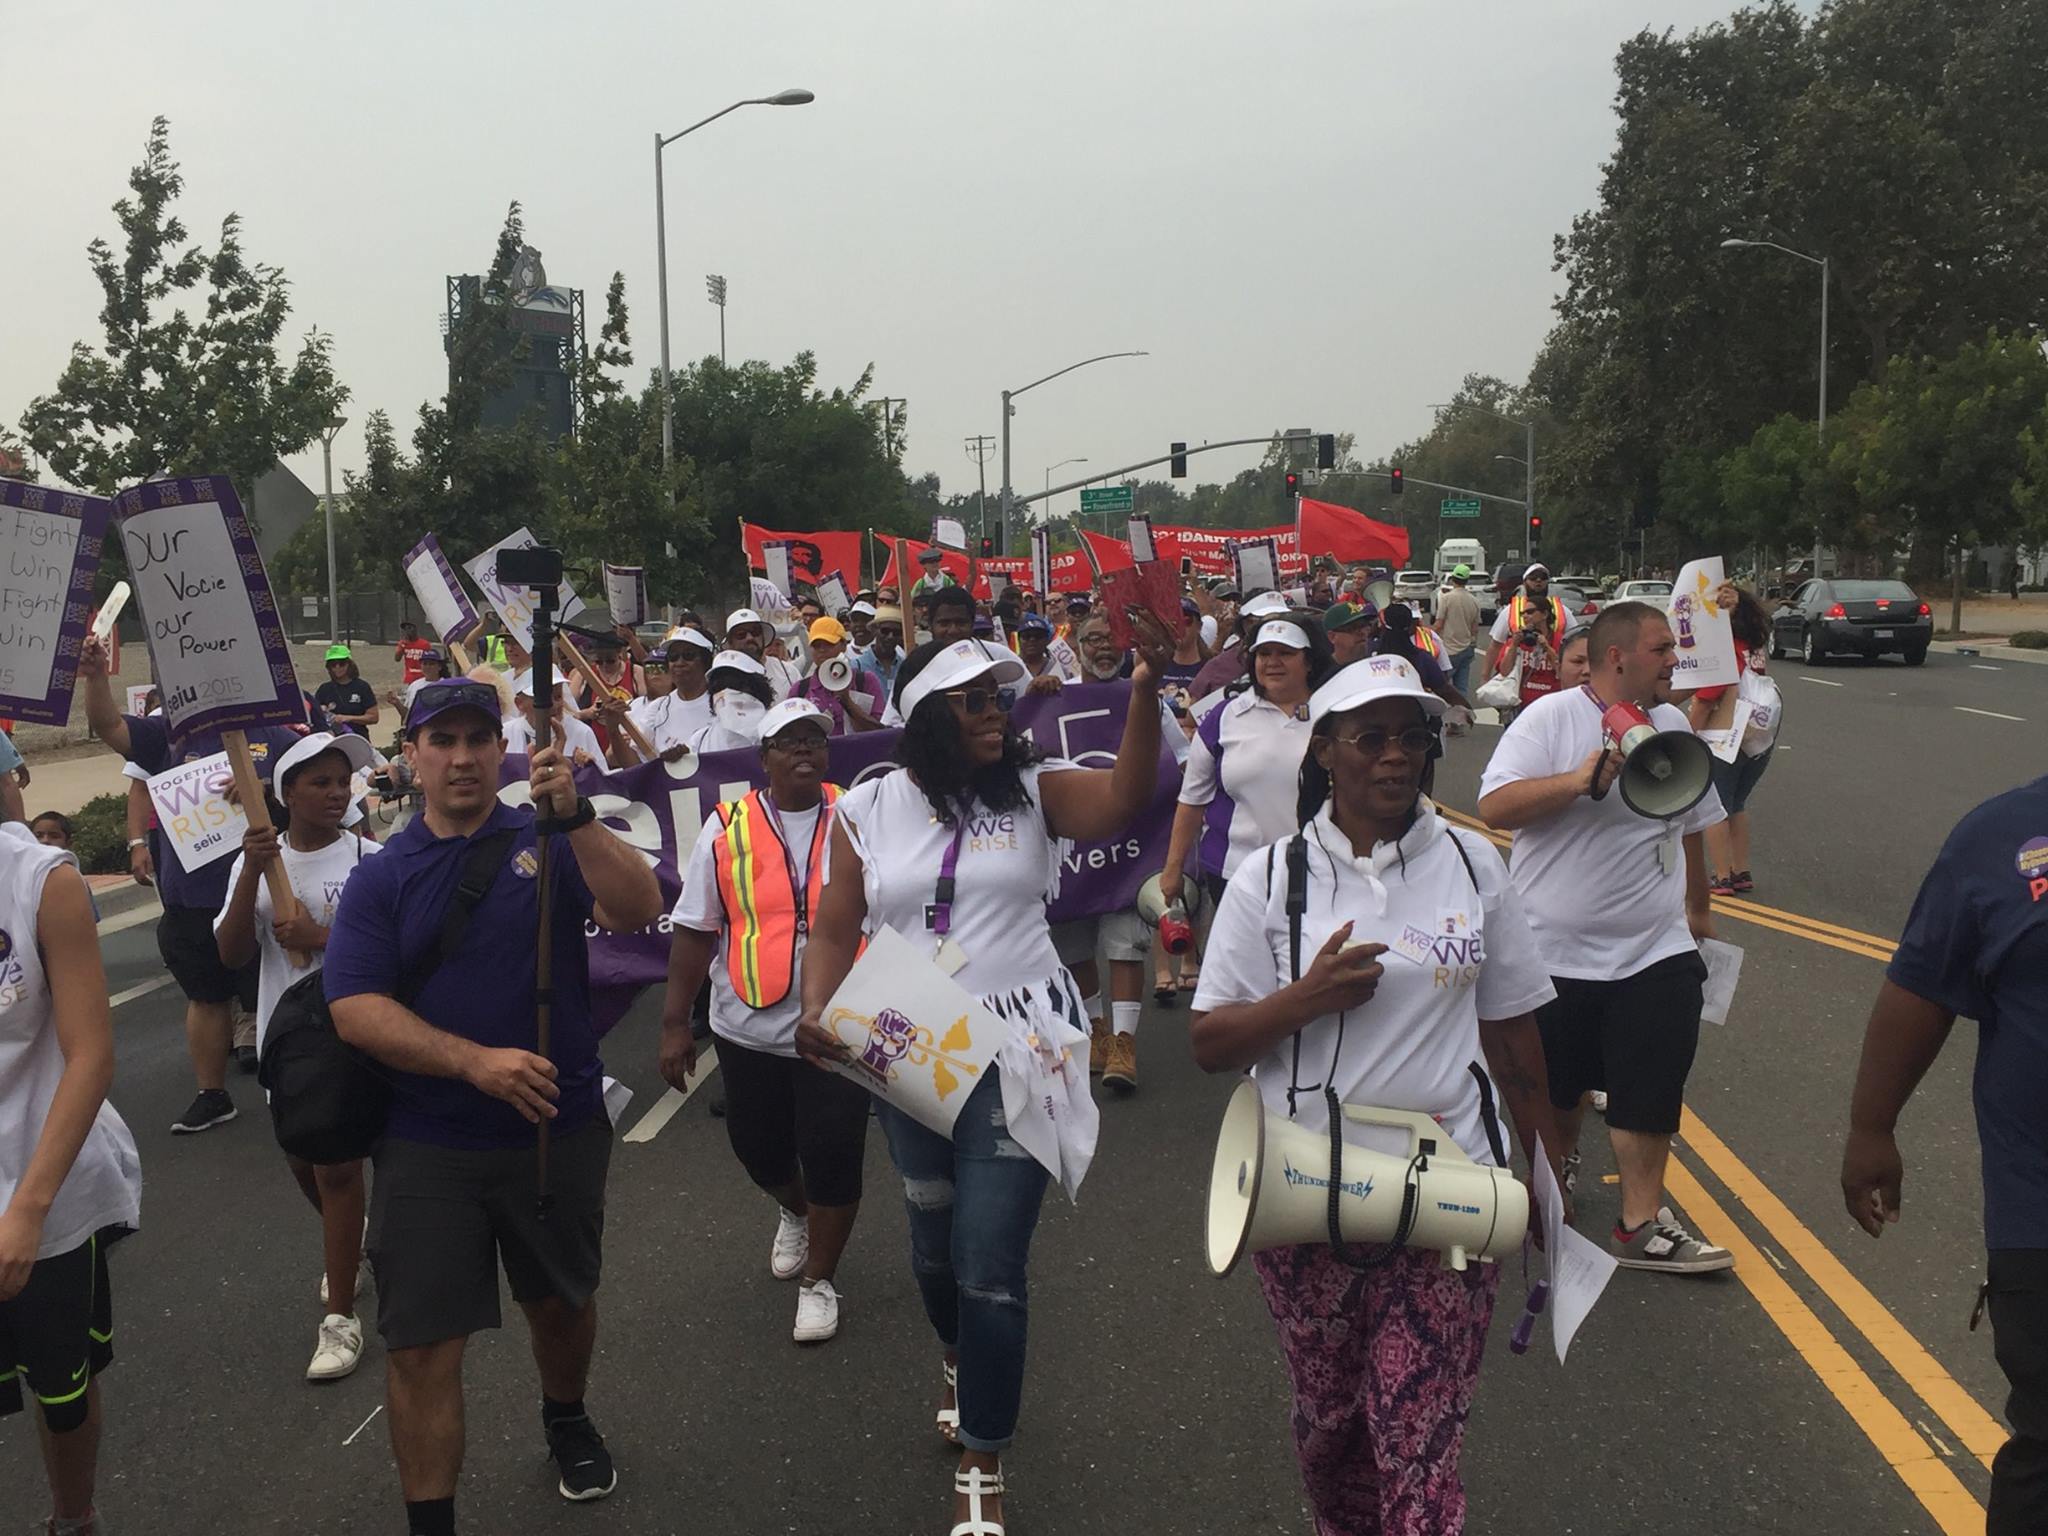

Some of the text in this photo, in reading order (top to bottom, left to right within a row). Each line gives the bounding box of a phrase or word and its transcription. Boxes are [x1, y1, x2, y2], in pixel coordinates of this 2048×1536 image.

[15, 510, 80, 547] Fight
[3, 588, 62, 619] Fight
[198, 676, 245, 699] 2015
[193, 832, 222, 853] seiu
[969, 833, 1019, 854] RISE
